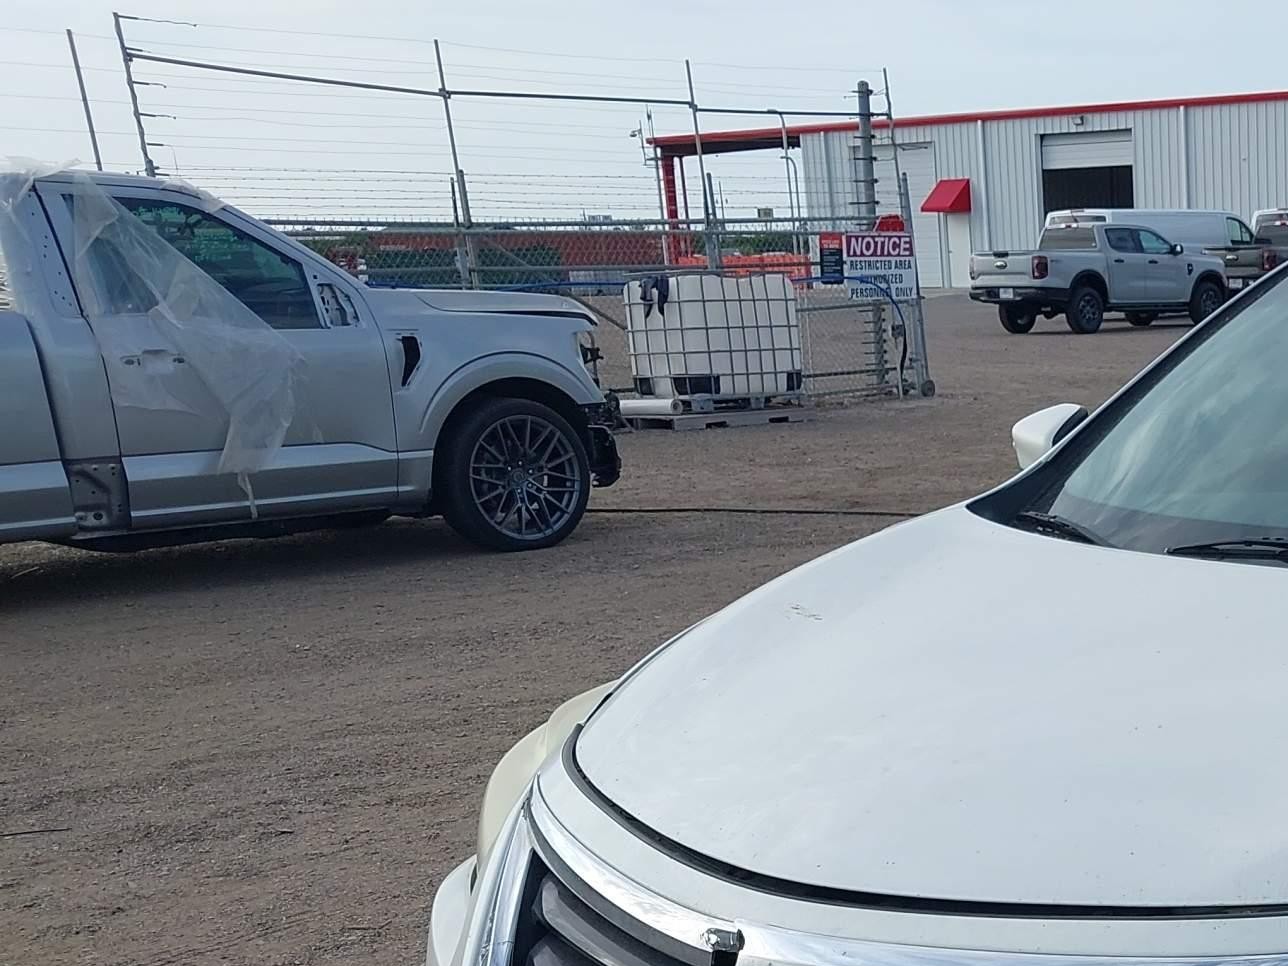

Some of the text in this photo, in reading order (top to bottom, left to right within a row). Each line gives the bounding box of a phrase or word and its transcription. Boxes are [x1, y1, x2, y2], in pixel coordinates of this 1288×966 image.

[849, 236, 911, 256] NOTICE
[850, 259, 893, 271] RESTRICTED
[894, 259, 912, 270] AREA
[894, 287, 913, 298] ONLY
